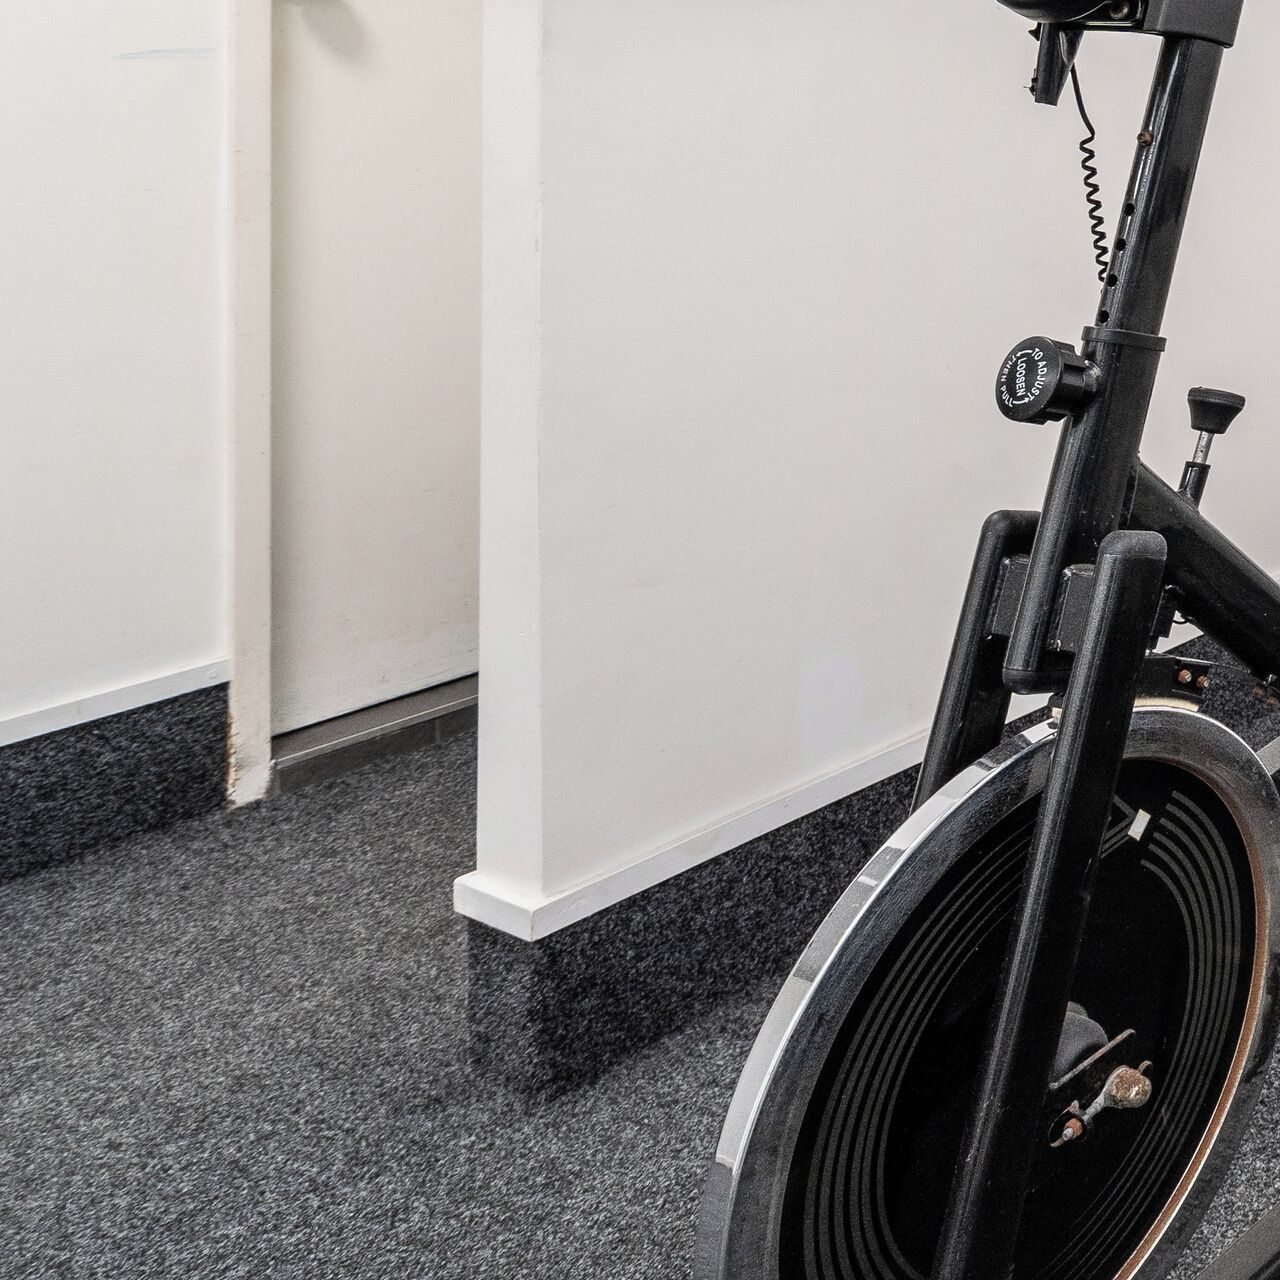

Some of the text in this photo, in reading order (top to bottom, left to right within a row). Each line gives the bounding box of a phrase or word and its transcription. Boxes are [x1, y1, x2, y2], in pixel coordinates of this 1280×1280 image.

[1000, 355, 1017, 407] THEN PULL
[1015, 357, 1027, 396] LOOSEN
[1027, 347, 1048, 401] TO ADJUST
